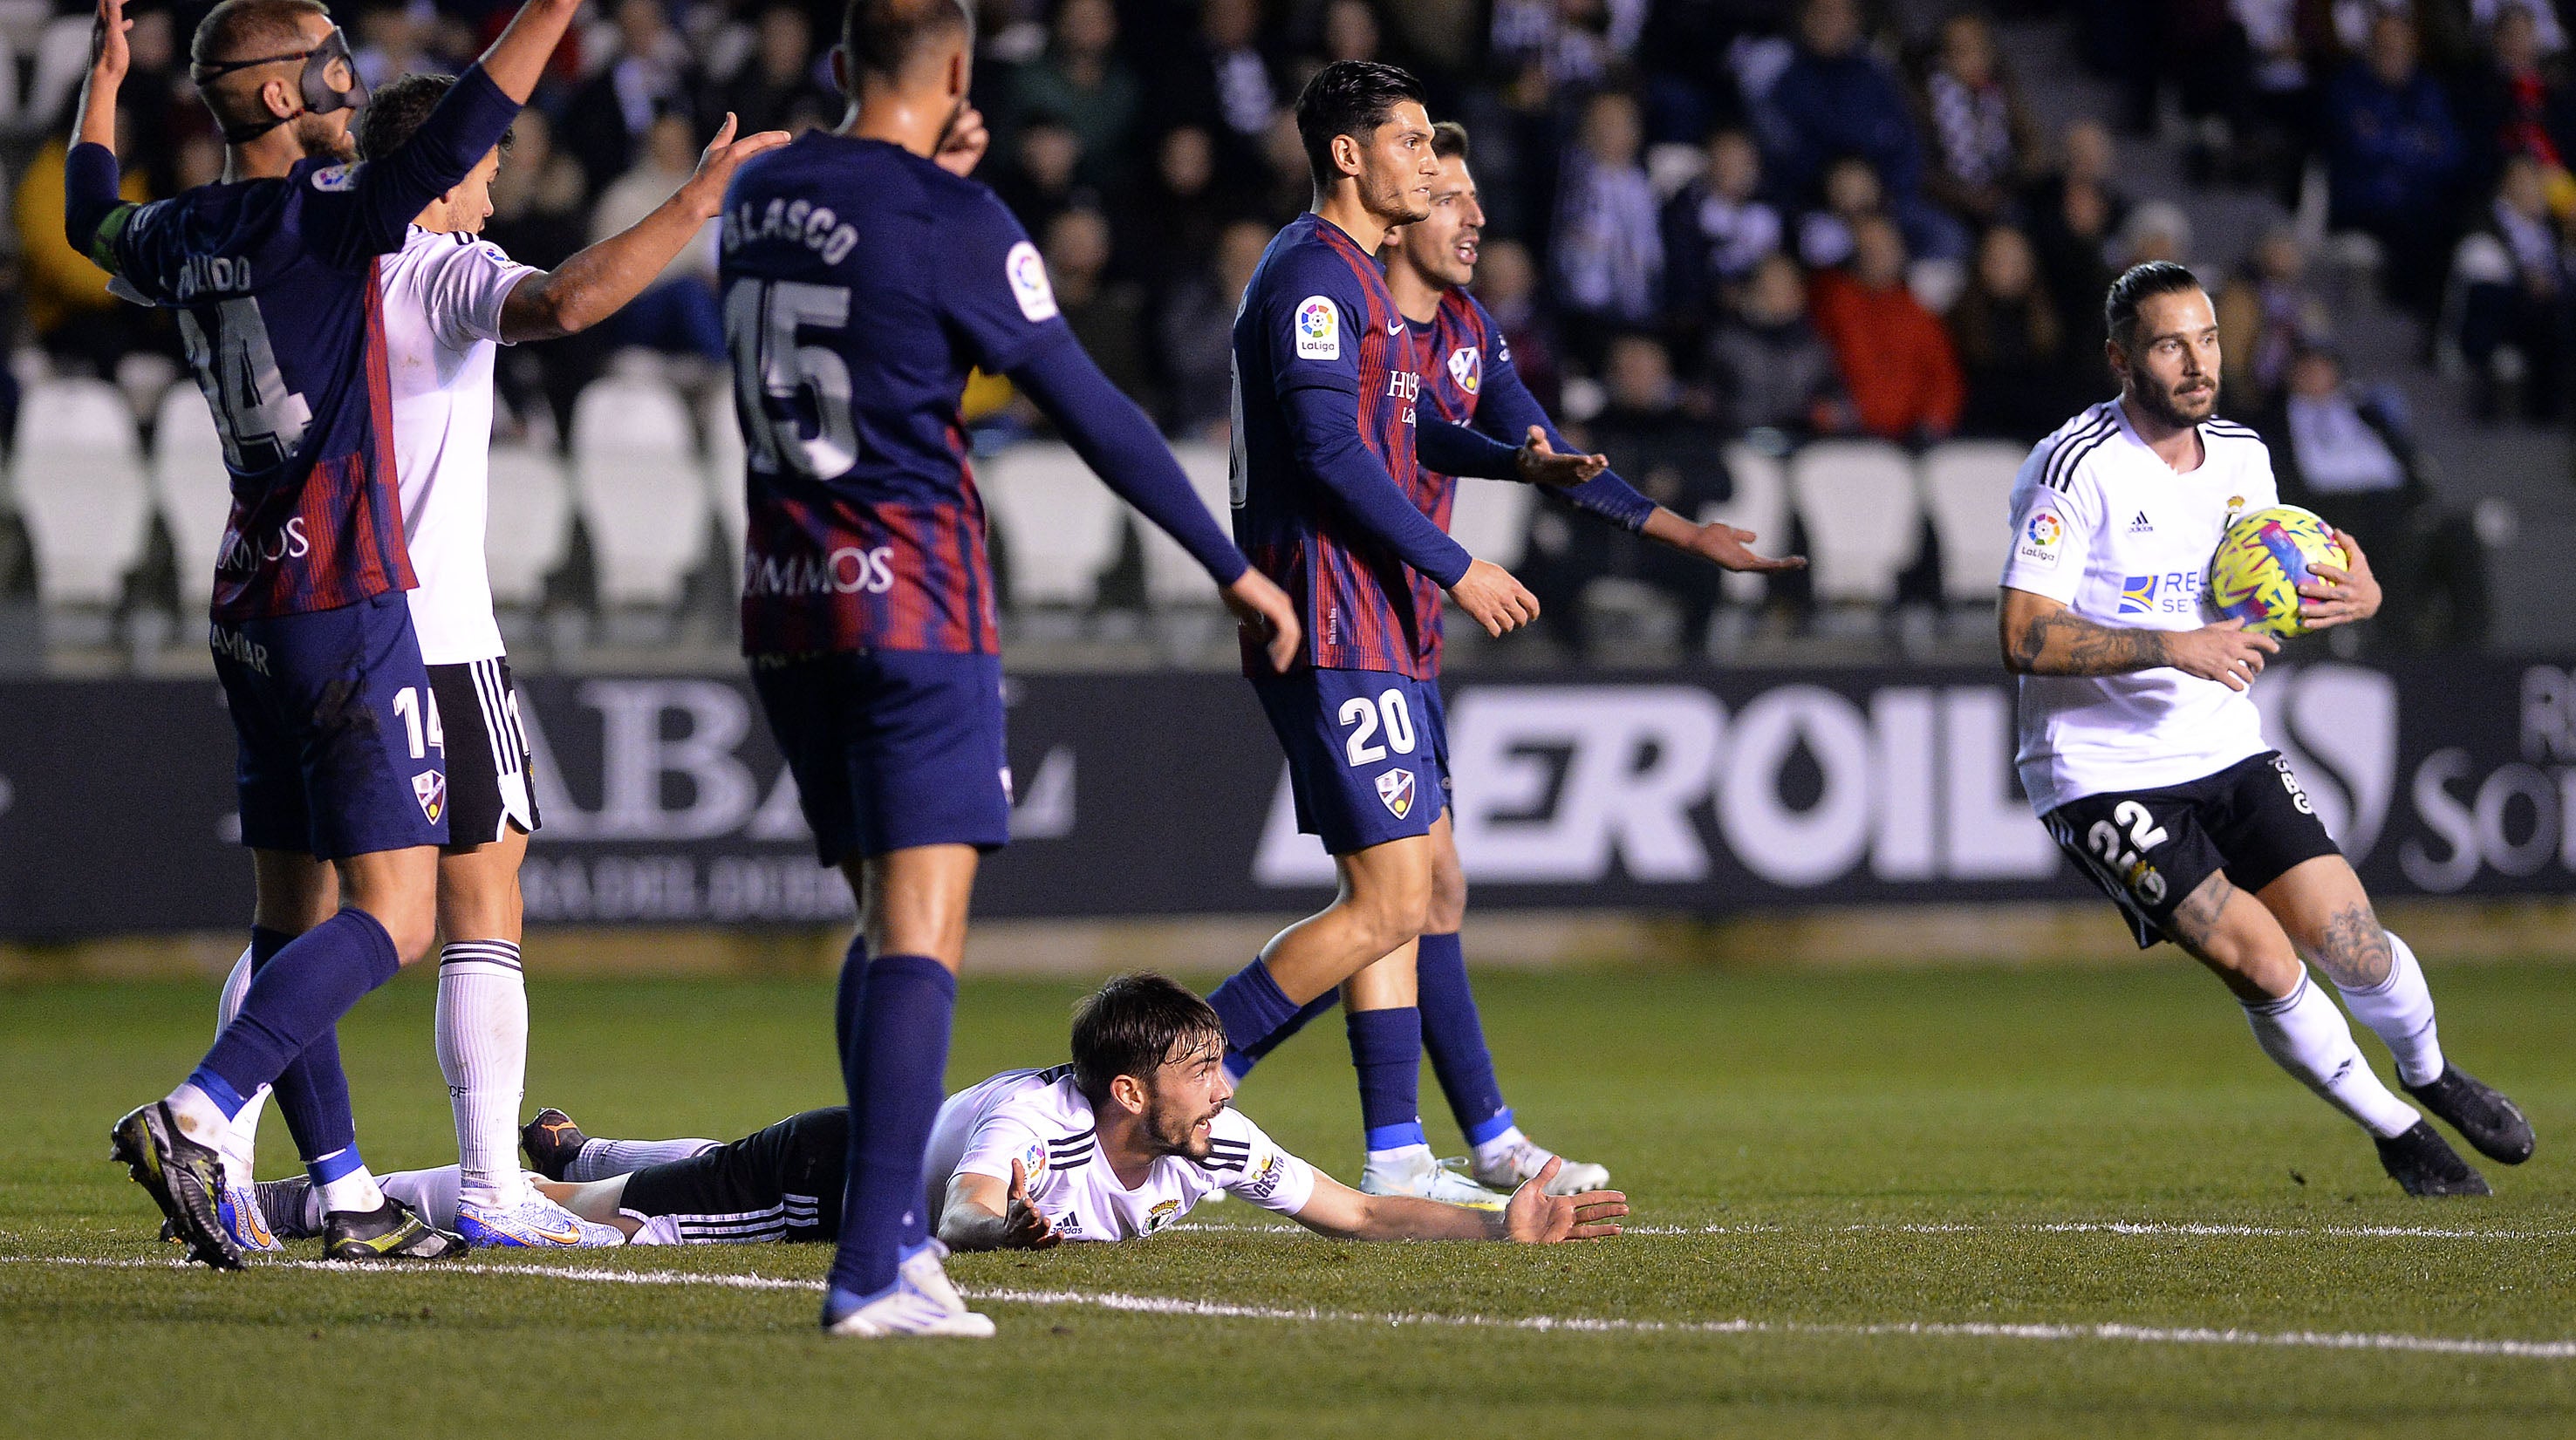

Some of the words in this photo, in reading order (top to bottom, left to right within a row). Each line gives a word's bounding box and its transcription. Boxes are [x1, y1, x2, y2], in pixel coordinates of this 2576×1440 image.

[723, 197, 858, 265] BLASCO
[725, 278, 859, 481] 15
[1302, 340, 1335, 351] LaLiga
[2021, 546, 2054, 562] LaLiga
[1338, 688, 1416, 767] 20
[2087, 800, 2169, 878] 22
[1050, 1225, 1083, 1234] adidas
